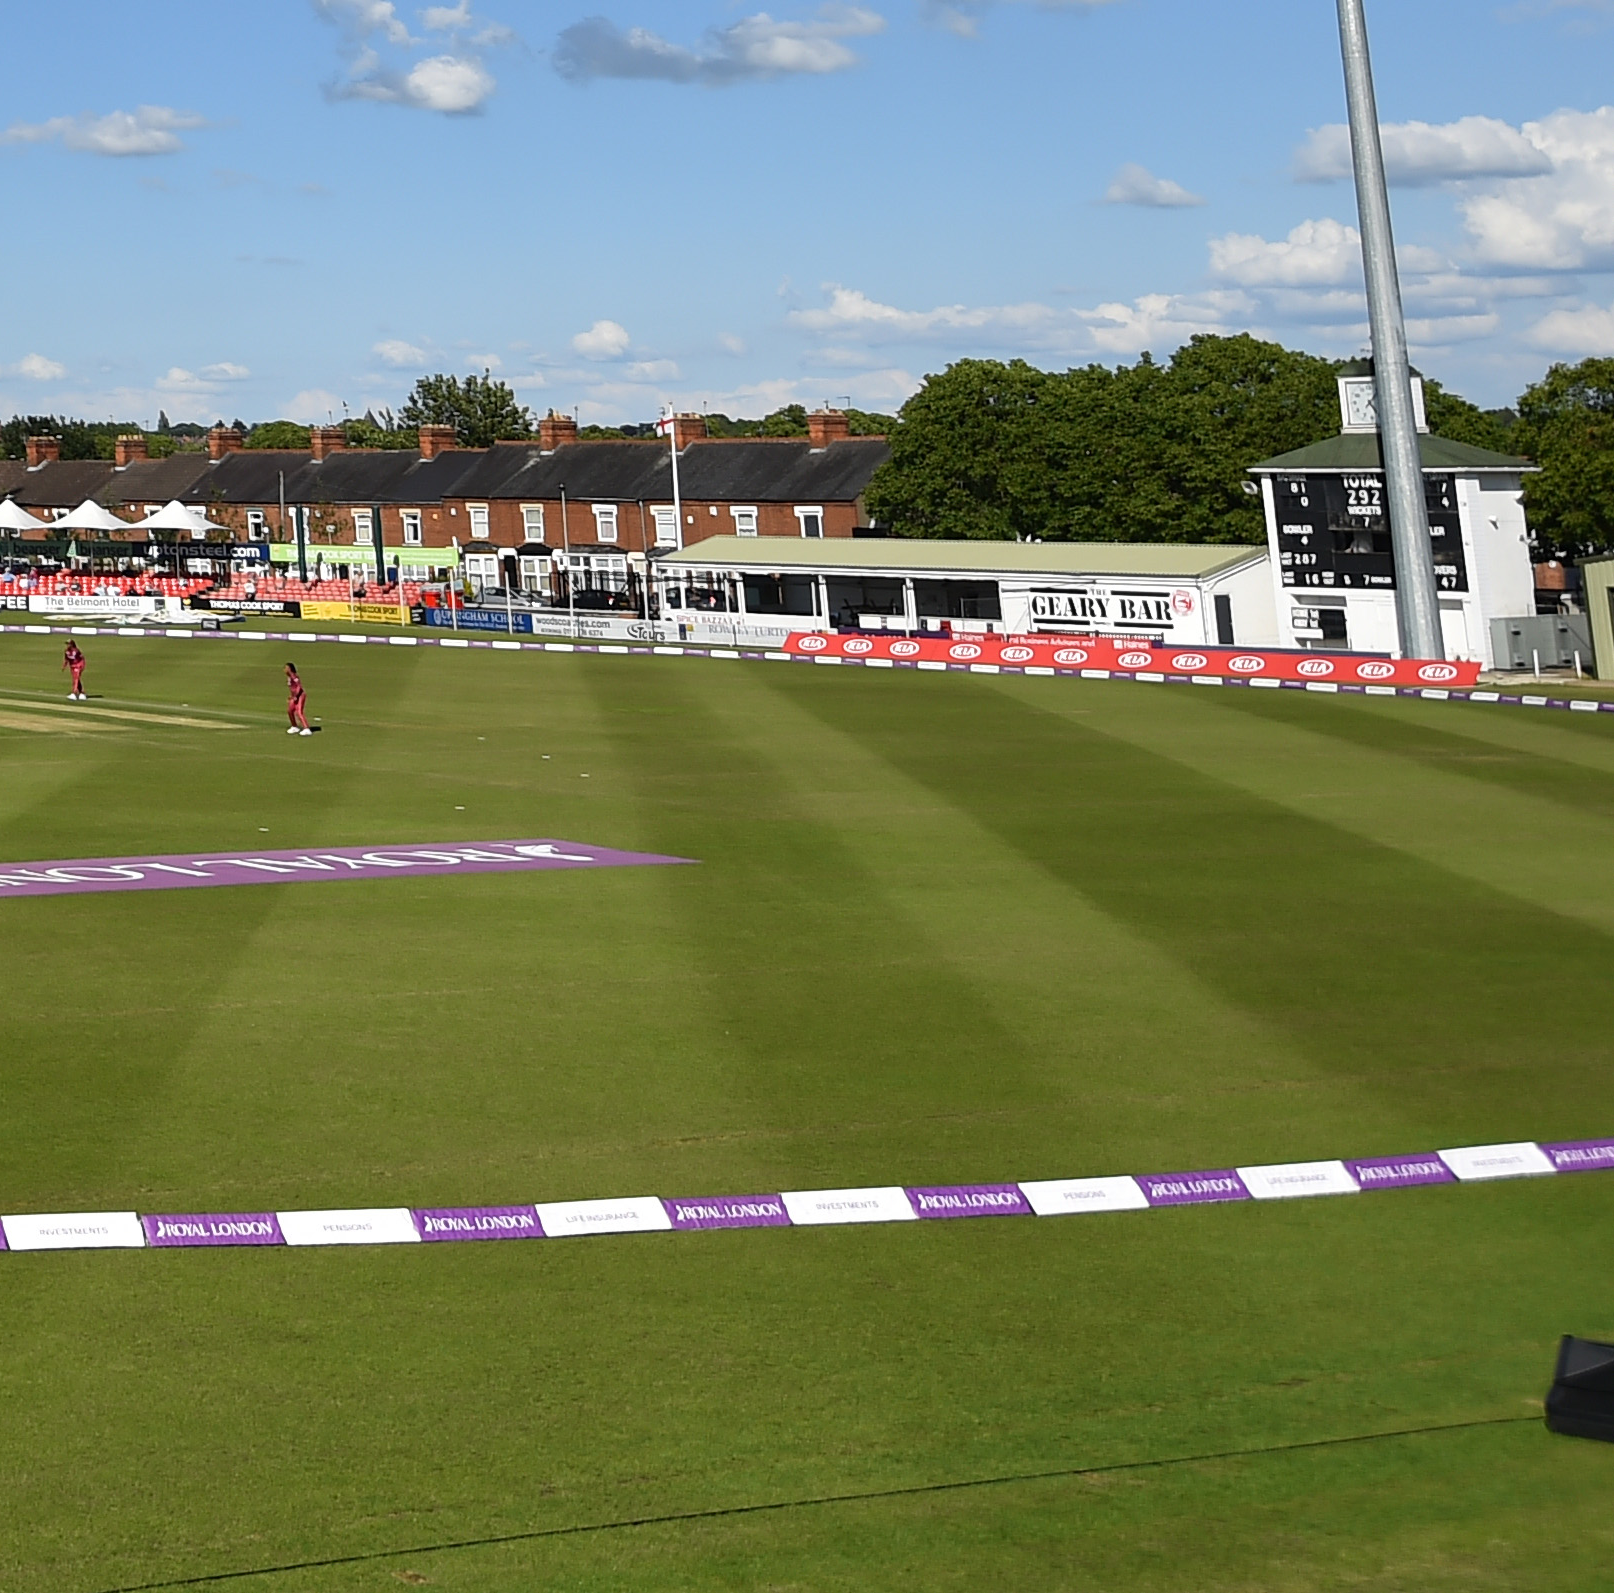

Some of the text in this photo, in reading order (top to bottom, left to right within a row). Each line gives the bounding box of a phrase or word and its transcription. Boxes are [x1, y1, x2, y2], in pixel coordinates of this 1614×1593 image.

[1342, 474, 1382, 488] TOTAL
[1300, 496, 1309, 507] 0
[1347, 490, 1380, 505] 292
[1347, 506, 1382, 515] WICKETS
[1363, 516, 1370, 527] 7
[1283, 525, 1313, 534] BOWLER
[143, 543, 260, 558] uptonsteel.com
[1294, 553, 1316, 565] 287
[1441, 577, 1457, 588] 47
[1091, 588, 1107, 596] THE
[45, 596, 140, 608] The Belmont Hotel
[209, 600, 284, 611] THOMAS COOK SPORT
[1032, 595, 1172, 620] GEARY BAR
[490, 613, 524, 624] SCHOL
[961, 634, 984, 642] Haines
[801, 639, 825, 649] KIA
[846, 641, 870, 651] KIA
[892, 643, 918, 654] KIA
[1123, 640, 1149, 649] Haines
[952, 646, 979, 657] KIA
[1003, 649, 1031, 660] KIA
[1056, 651, 1085, 662] KIA
[1120, 654, 1149, 666] KIA
[1174, 656, 1205, 667] KIA
[1231, 658, 1262, 670] KIA
[1299, 662, 1331, 673] KIA
[1360, 665, 1393, 676] KIA
[1421, 667, 1454, 678] KIA
[193, 843, 530, 873] ROYAL
[1152, 1177, 1240, 1197] ROYAL LONDON
[816, 1199, 880, 1211] INVESTMENTS
[925, 1191, 1020, 1209] ROYAL LONDON
[683, 1201, 782, 1220] ROYAL LONDON
[565, 1210, 640, 1224] LIFE INSURANCE
[165, 1219, 272, 1237] ROYAL LONDON
[322, 1223, 373, 1232] PENSIONS
[432, 1214, 535, 1232] ROYAL LONDON
[39, 1226, 109, 1236] INVESTMENTS
